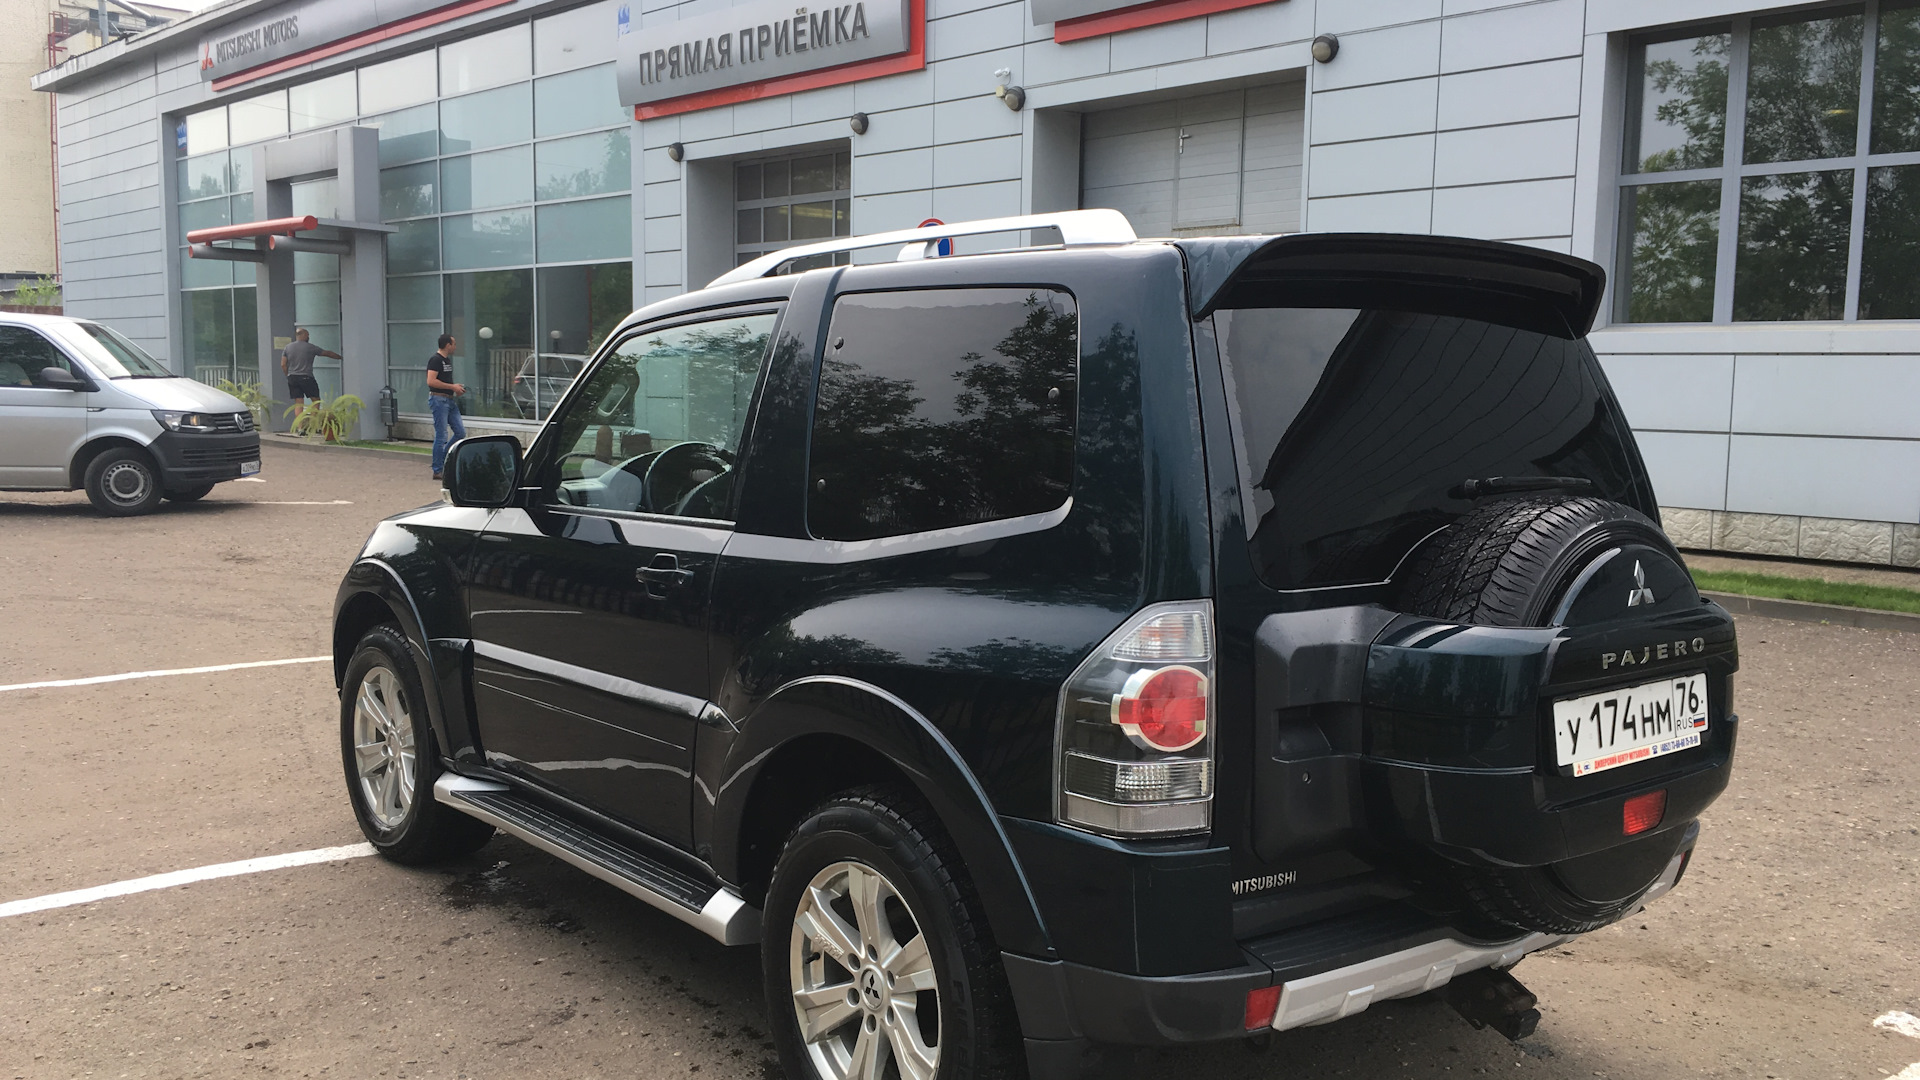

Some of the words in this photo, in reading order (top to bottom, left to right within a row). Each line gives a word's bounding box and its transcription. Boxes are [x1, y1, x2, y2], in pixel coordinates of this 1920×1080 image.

[216, 29, 261, 63] MITSUBISHI
[263, 15, 299, 47] MOTORS
[639, 33, 734, 86] ПРЯМАЯ
[739, 1, 870, 65] ПРИЁМКА
[1602, 637, 1705, 669] PAJERO
[1676, 680, 1699, 717] 76
[1676, 717, 1693, 731] RUS
[1232, 871, 1296, 894] MITSUBISHI
